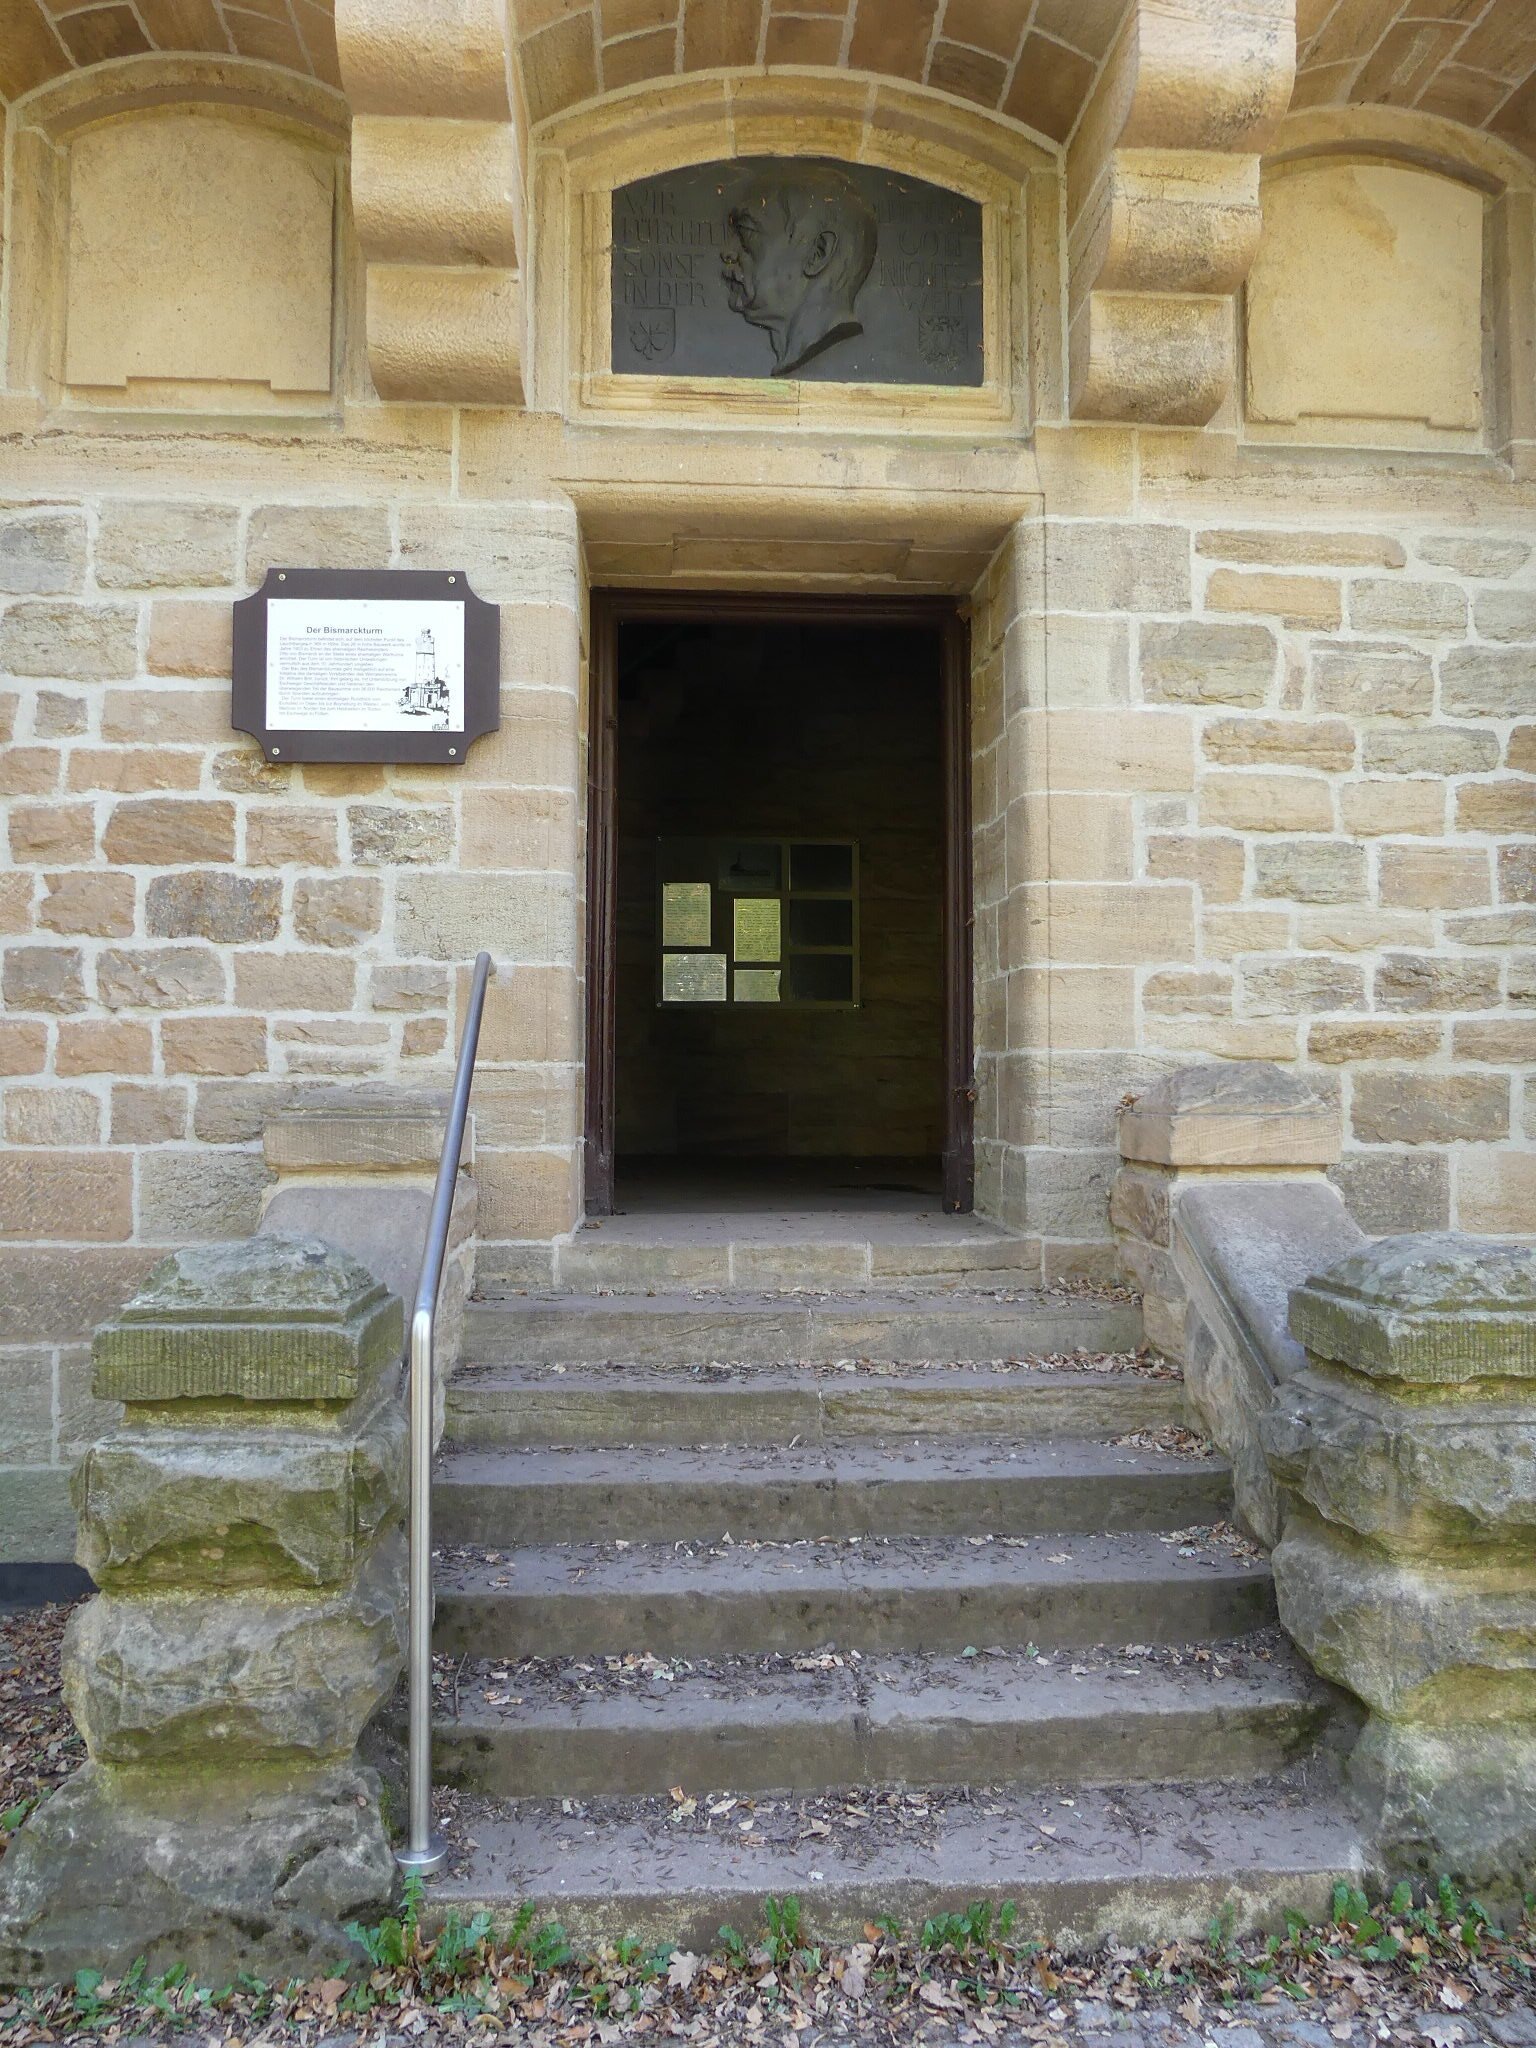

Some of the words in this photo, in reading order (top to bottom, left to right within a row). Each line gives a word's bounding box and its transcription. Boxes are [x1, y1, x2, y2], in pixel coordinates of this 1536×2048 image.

[623, 190, 677, 216] WIR
[623, 250, 705, 279] SONST
[658, 279, 707, 307] DER
[306, 626, 322, 634] Der
[323, 626, 383, 635] Bismarckturm
